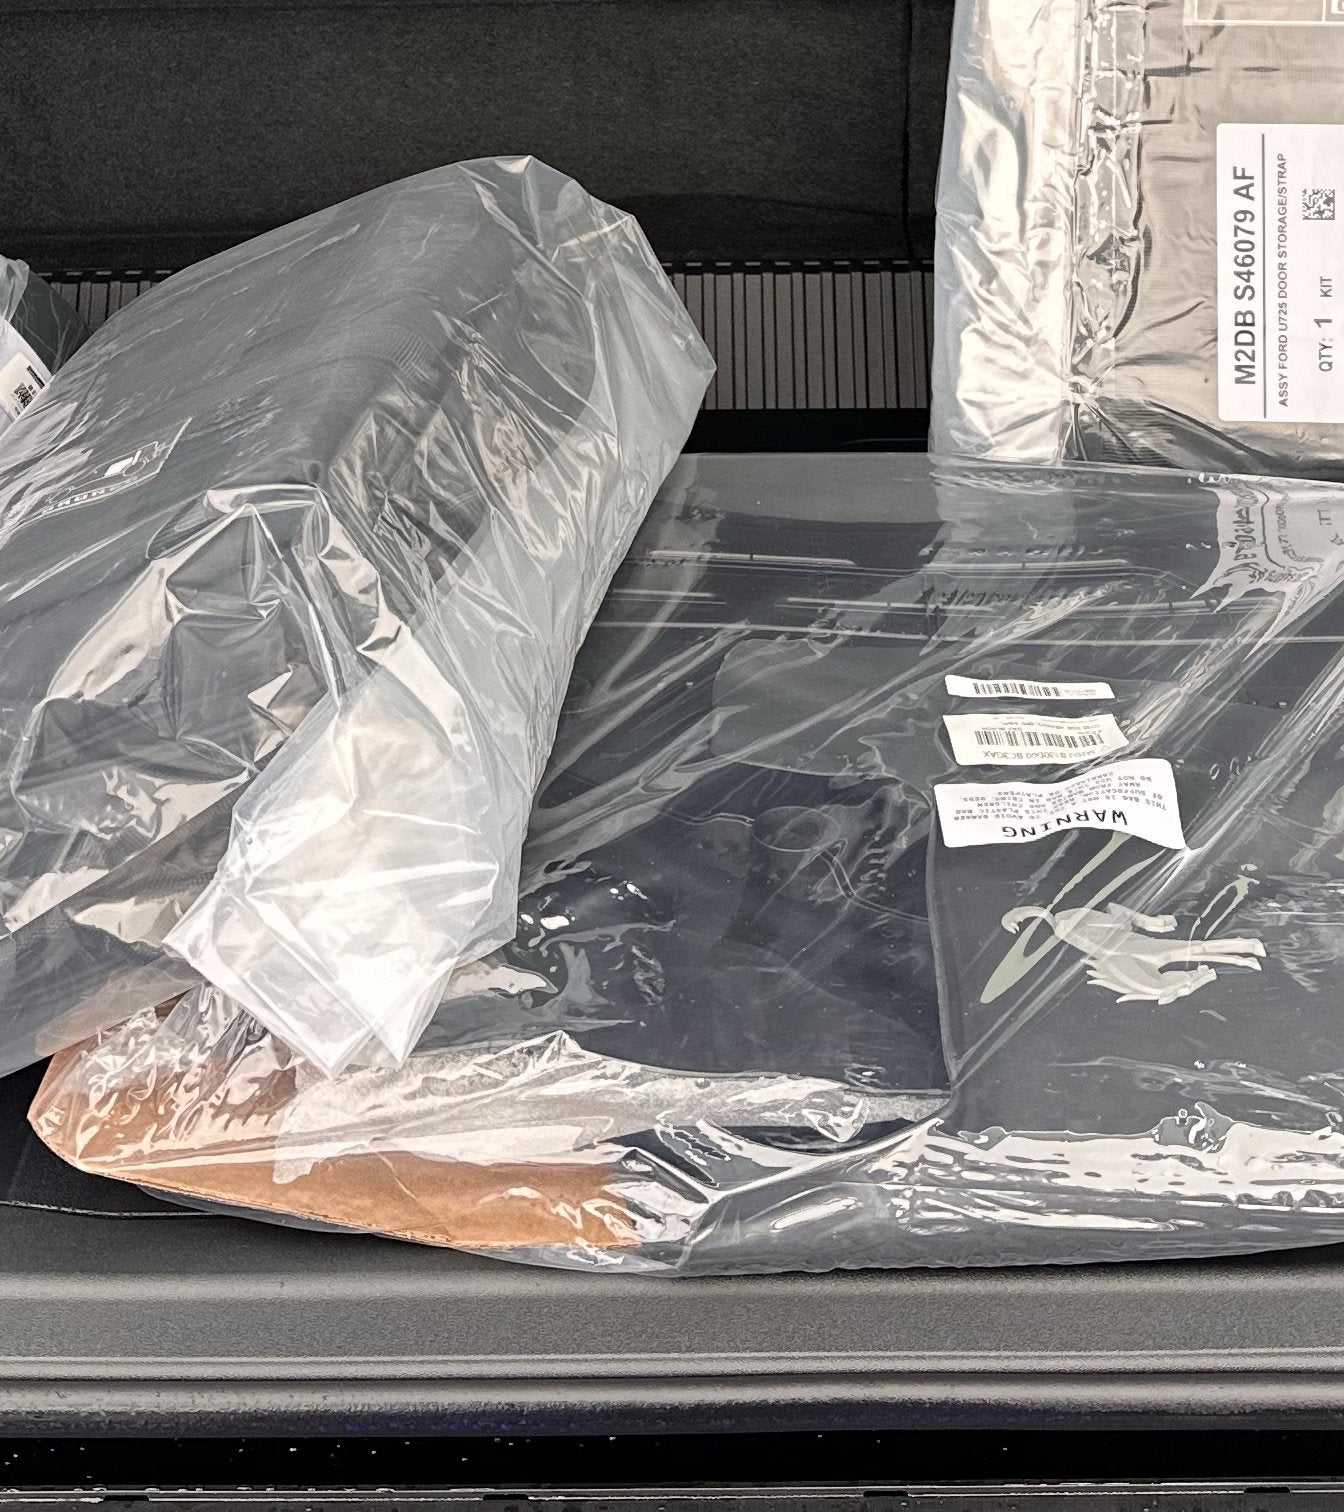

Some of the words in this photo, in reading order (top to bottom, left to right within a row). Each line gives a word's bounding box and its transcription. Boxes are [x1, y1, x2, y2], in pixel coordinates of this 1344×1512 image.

[1232, 166, 1254, 201] AF
[1277, 153, 1287, 258] STORAGE/STRAP
[1233, 209, 1255, 301] S46079
[1277, 262, 1287, 299] DOOR
[1320, 276, 1332, 298] KIT
[1278, 302, 1288, 332] U725
[1313, 318, 1333, 328] 1
[1234, 310, 1256, 385] M2DB
[1278, 335, 1288, 370] FORD
[1318, 337, 1333, 372] QTY:
[1278, 373, 1288, 408] ASSY
[1001, 809, 1128, 838] WARNING
